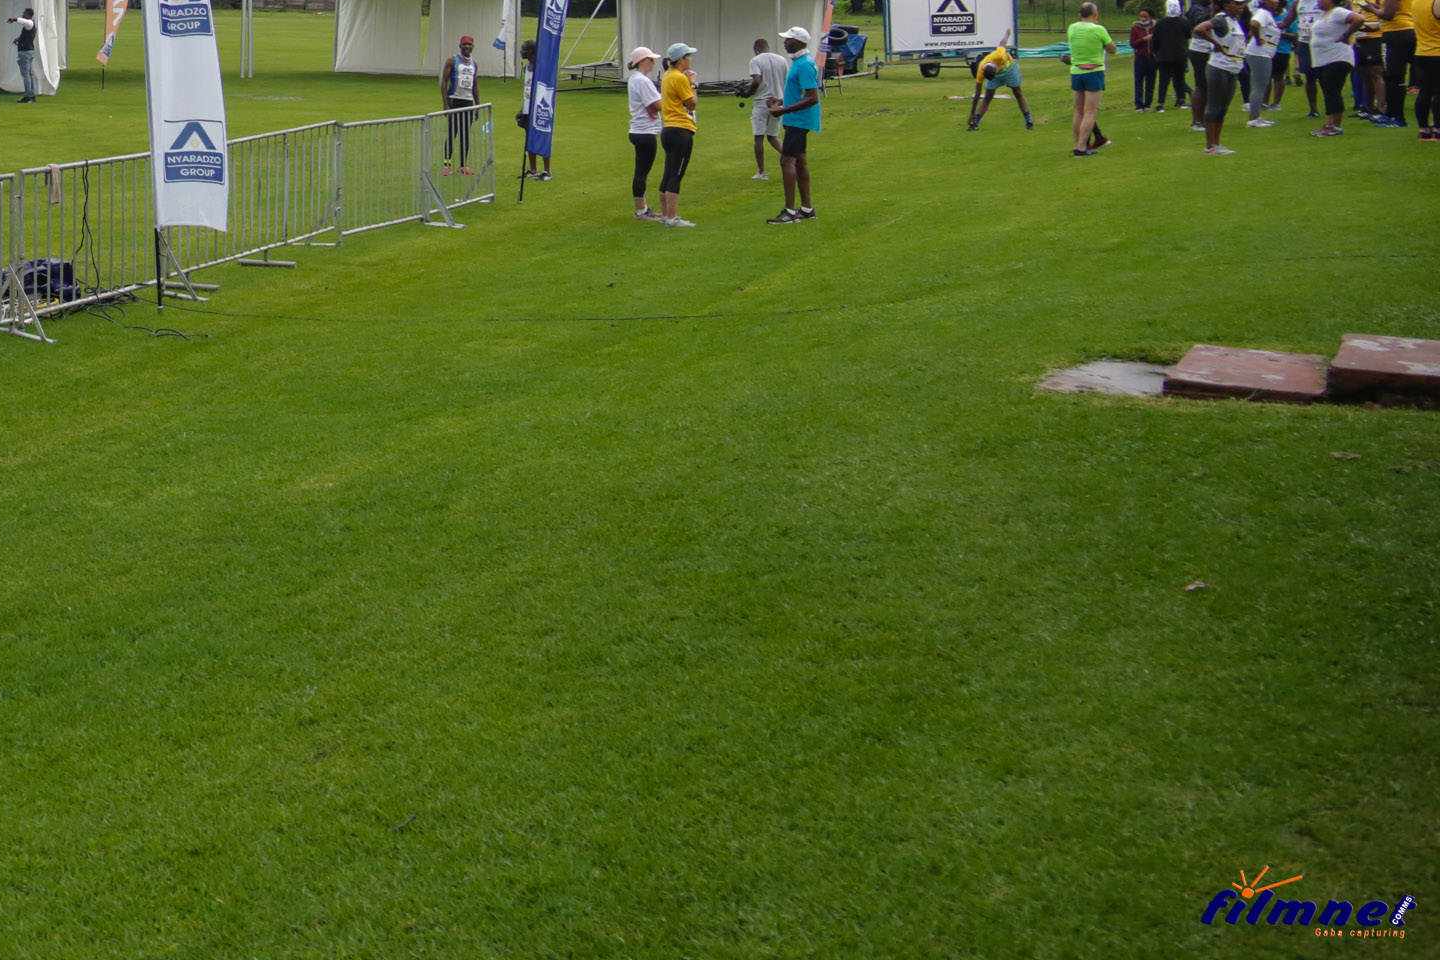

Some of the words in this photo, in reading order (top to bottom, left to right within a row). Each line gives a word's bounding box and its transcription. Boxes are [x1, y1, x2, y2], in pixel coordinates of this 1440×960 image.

[924, 40, 984, 48] www.nyaradzo.co.zw
[167, 154, 221, 164] NYARADZO
[180, 168, 215, 177] GROUP
